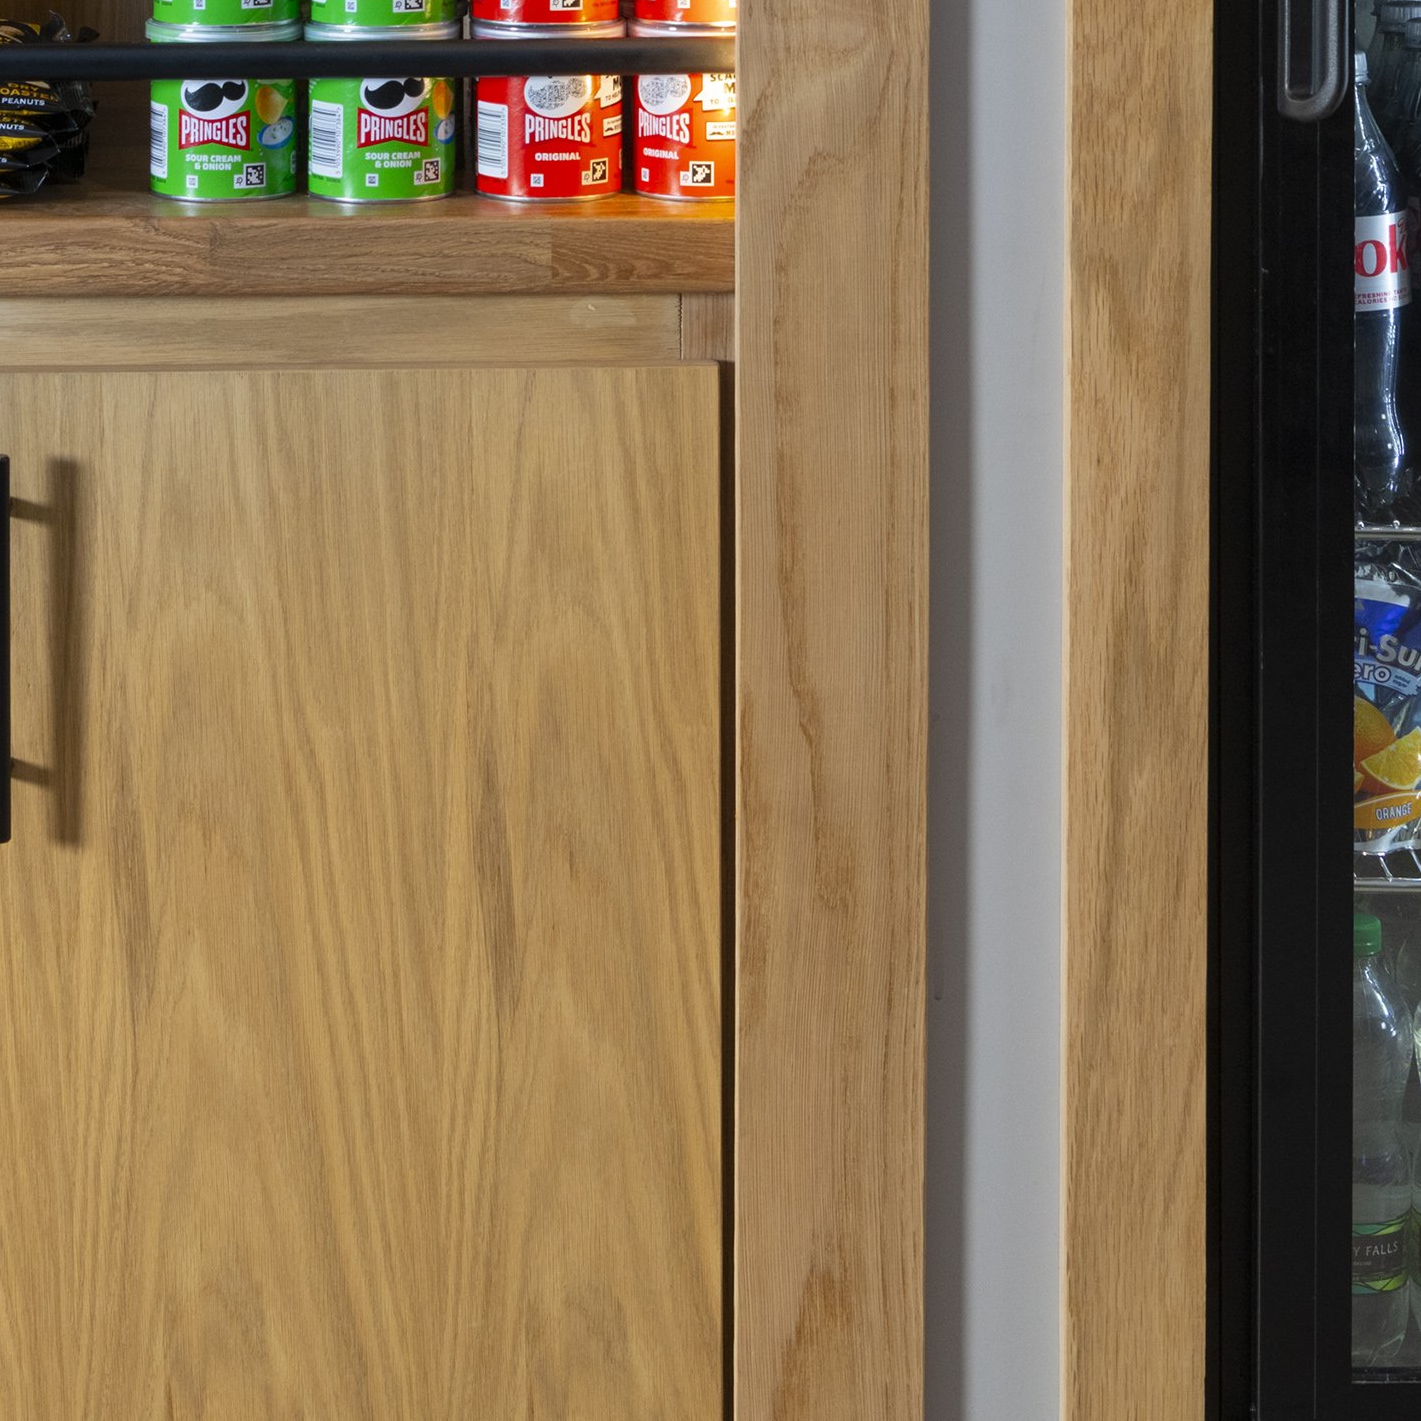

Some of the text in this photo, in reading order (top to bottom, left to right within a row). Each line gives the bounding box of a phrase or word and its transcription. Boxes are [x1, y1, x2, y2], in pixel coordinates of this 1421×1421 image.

[1, 97, 46, 106] PEANUTS
[181, 114, 247, 147] PRINGLES
[524, 113, 590, 144] PRINGLES
[534, 152, 581, 162] ORIGINAL
[1376, 803, 1412, 820] ORANGE
